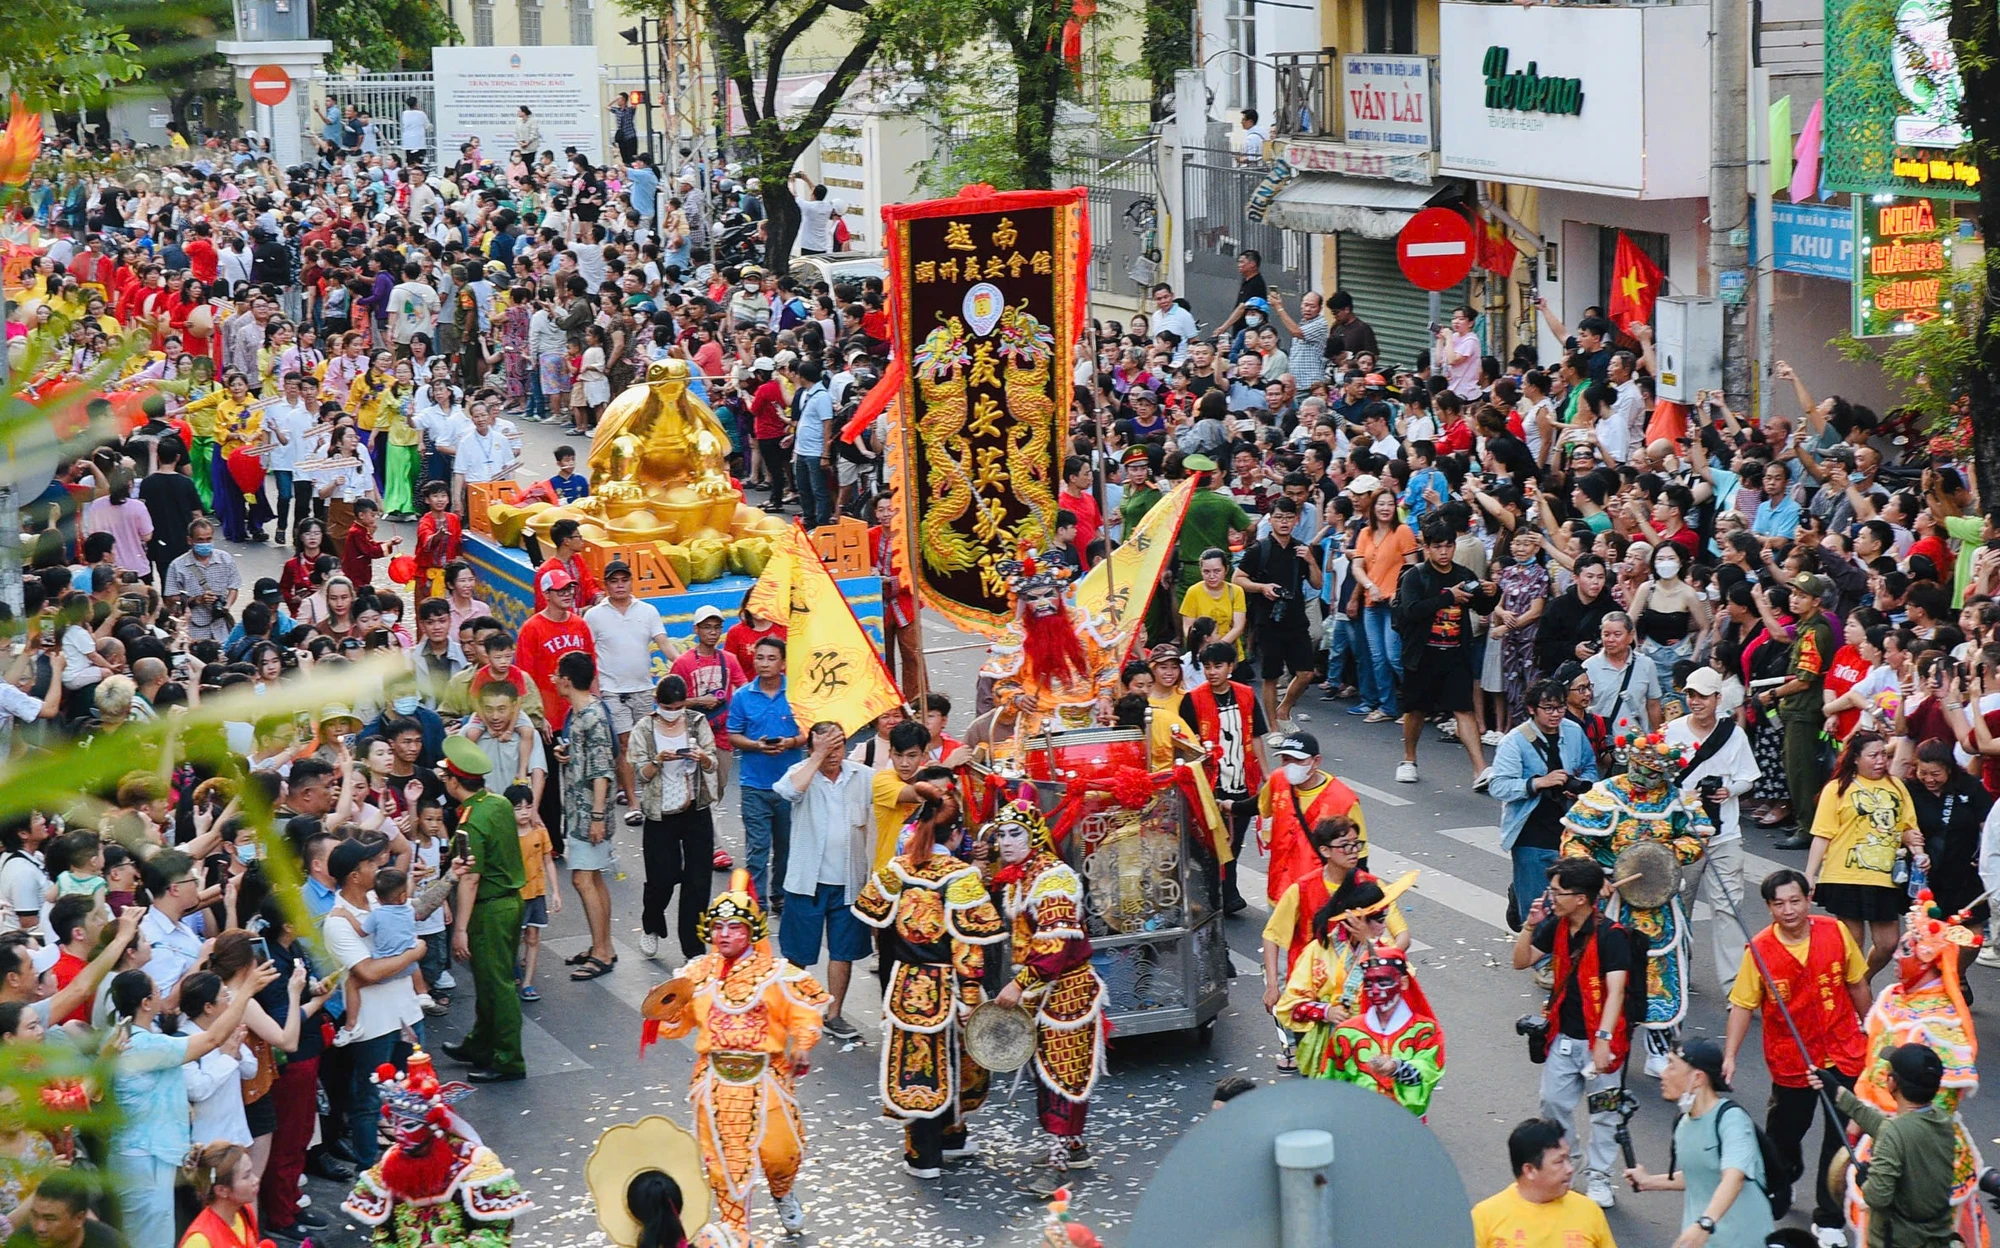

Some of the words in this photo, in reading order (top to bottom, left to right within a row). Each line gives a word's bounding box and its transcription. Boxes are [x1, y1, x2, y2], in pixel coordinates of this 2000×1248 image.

[1349, 82, 1387, 121] VĂN
[1391, 81, 1424, 123] LÀI
[1880, 199, 1935, 236] NHÀ
[1791, 233, 1834, 260] KHU
[1874, 278, 1941, 311] CHAY
